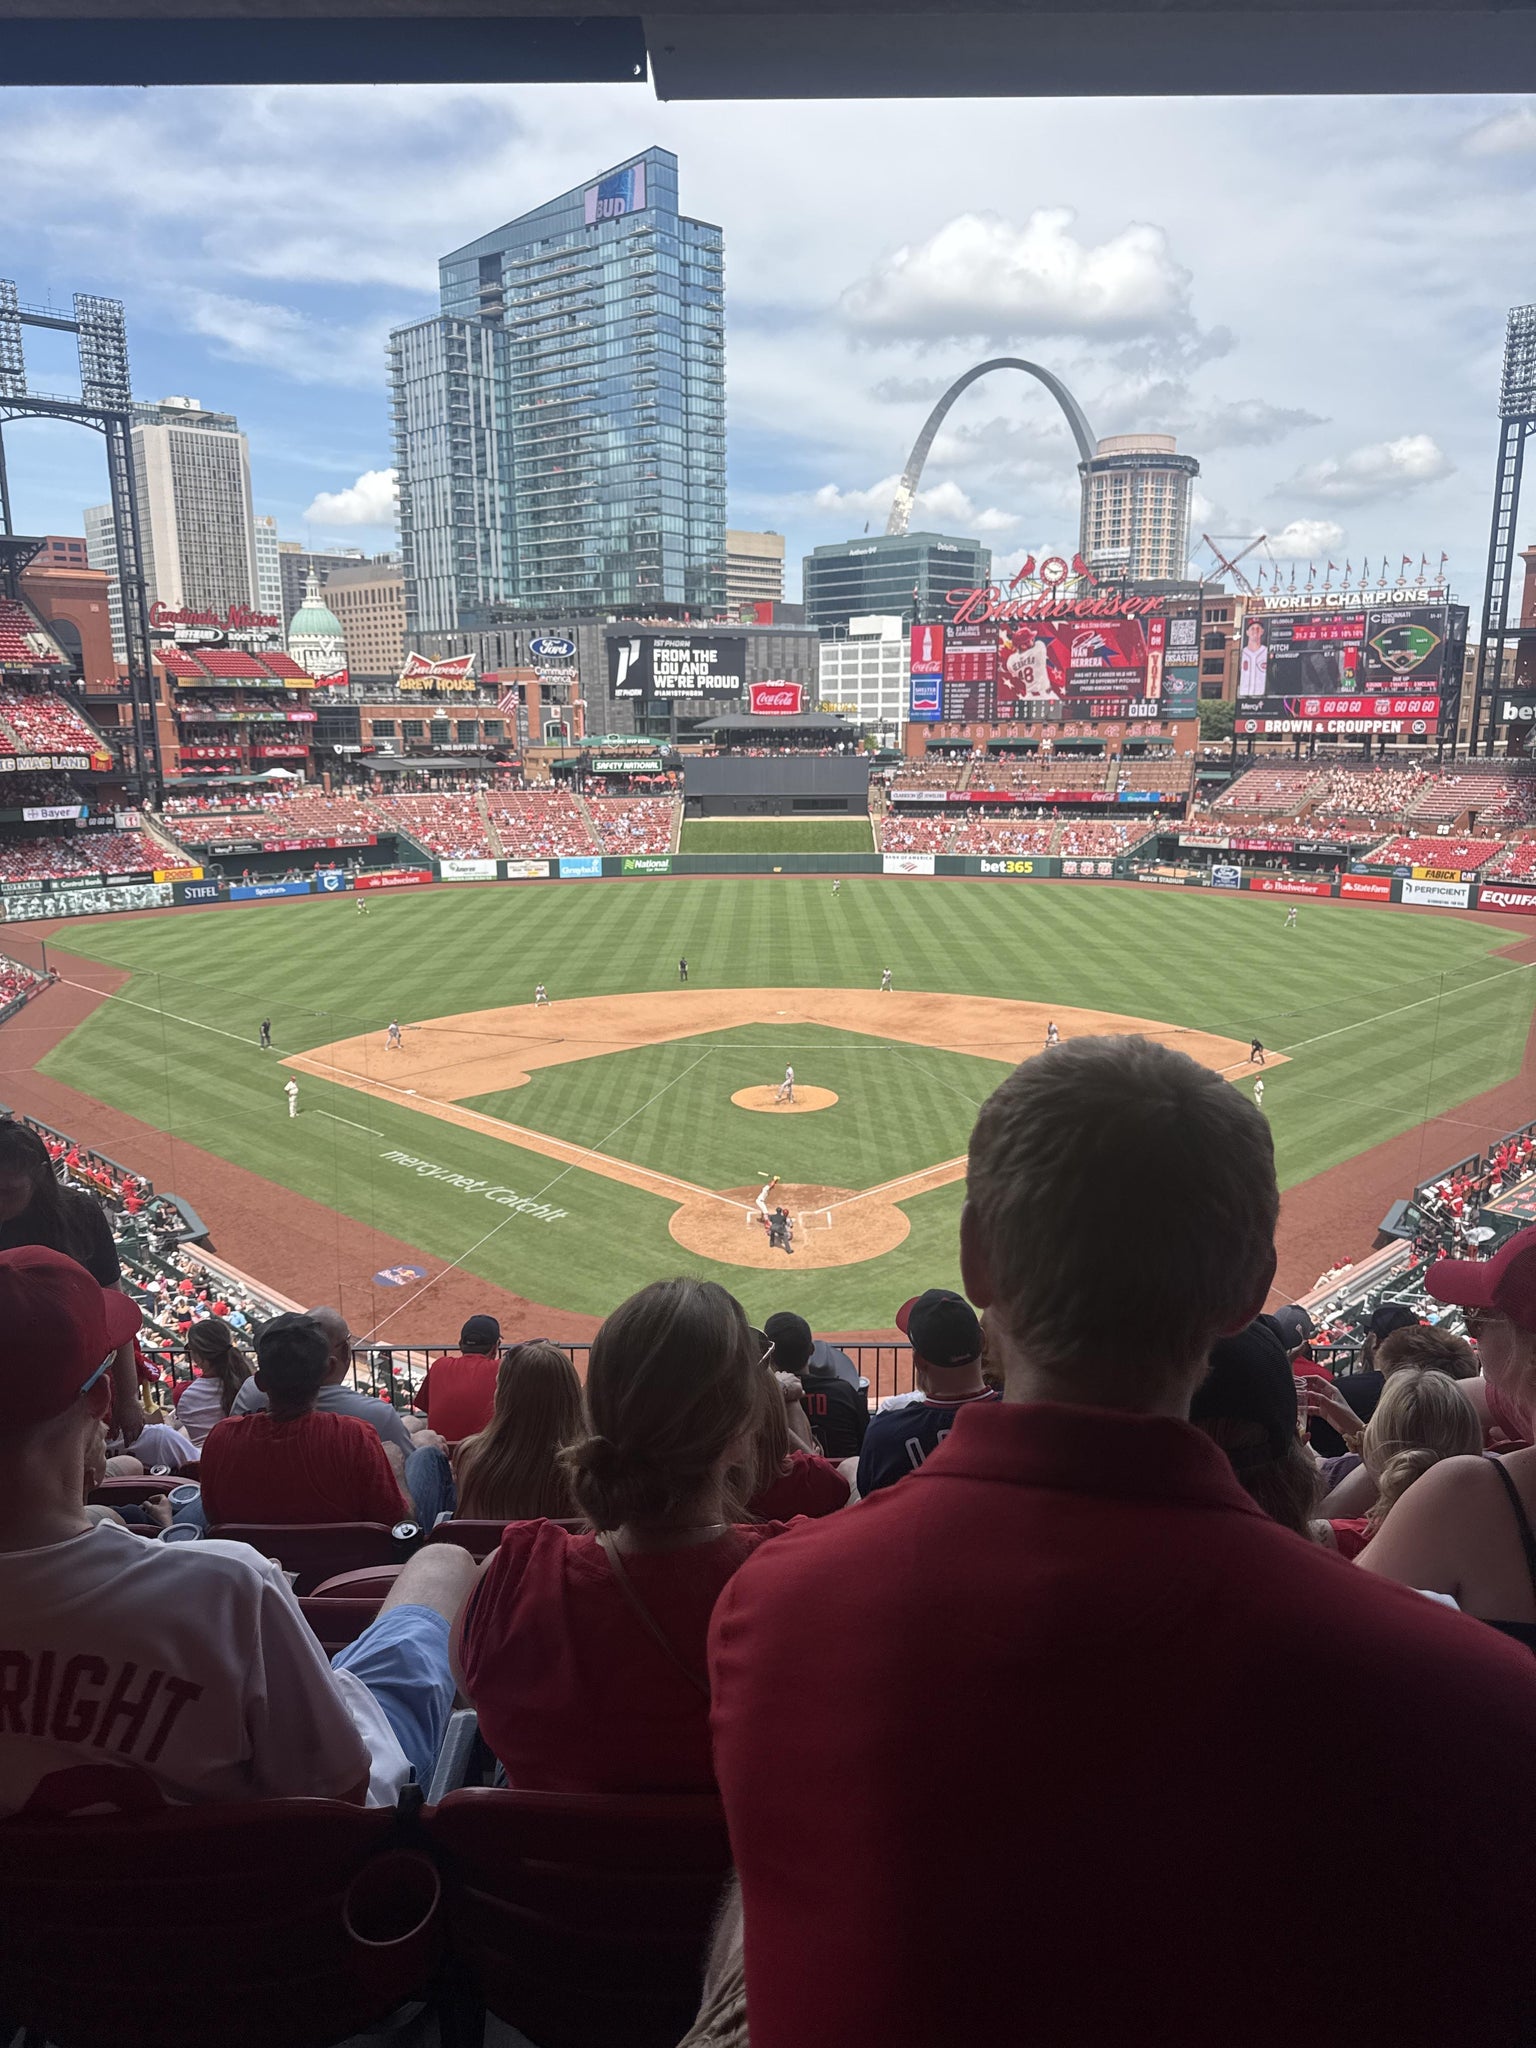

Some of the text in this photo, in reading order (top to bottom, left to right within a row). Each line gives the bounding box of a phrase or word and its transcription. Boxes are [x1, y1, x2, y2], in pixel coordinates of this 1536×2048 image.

[596, 198, 626, 220] BUD
[945, 586, 1166, 624] Budweiser
[1264, 590, 1429, 609] WORLD CHAMPIONS
[150, 602, 278, 630] Cardinals Nation
[540, 640, 567, 654] Ford
[654, 649, 718, 662] FROM THE
[404, 662, 473, 676] Budweiser
[535, 666, 578, 677] Community
[654, 662, 709, 675] LOU AND
[654, 676, 739, 688] WE'RE PROUD
[1151, 655, 1159, 697] VOTE
[400, 678, 476, 691] BREW HOUSE
[1241, 703, 1259, 712] Mercy
[1265, 720, 1401, 733] BROWN & CROUPPEN
[16, 757, 51, 771] MAC
[52, 757, 90, 771] LAND
[41, 808, 70, 818] Bayer
[635, 859, 669, 869] National
[981, 860, 1033, 873] bet365
[382, 876, 420, 886] Budweiser
[1159, 876, 1185, 885] STADIUM
[1425, 870, 1456, 880] FABICK
[1462, 872, 1476, 881] CAT
[61, 880, 83, 888] Central
[85, 878, 102, 886] Bank
[1274, 882, 1318, 893] Budweiser
[184, 886, 218, 899] STIFEL
[1414, 886, 1467, 896] PERFICIENT
